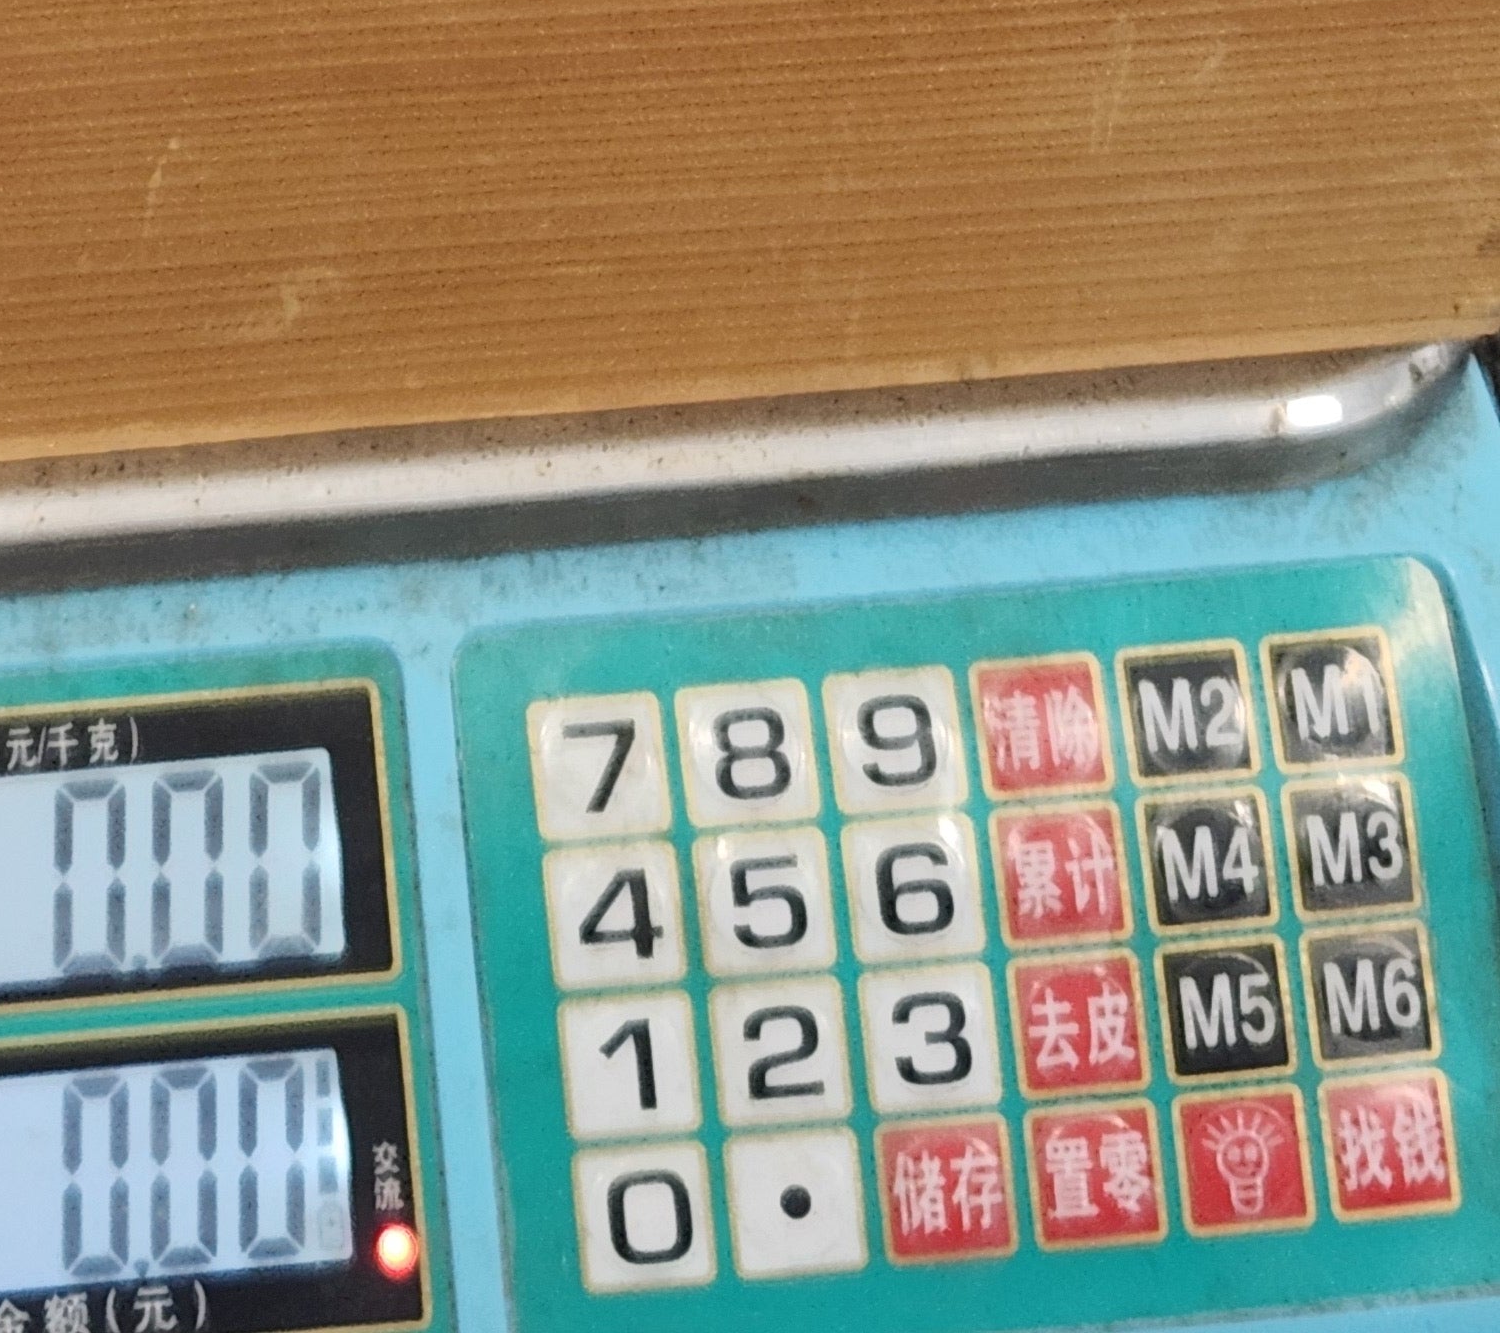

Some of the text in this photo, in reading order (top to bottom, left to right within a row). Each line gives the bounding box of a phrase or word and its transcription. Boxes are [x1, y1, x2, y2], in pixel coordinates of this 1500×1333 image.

[858, 693, 937, 786] 9
[994, 690, 1100, 773] 清除
[1141, 679, 1240, 750] M2
[1293, 664, 1384, 738] M1
[562, 718, 636, 814] 7
[714, 707, 791, 801] 8
[53, 760, 322, 975] 0.00
[875, 842, 954, 935] 6
[1014, 838, 1115, 919] 累计
[1162, 828, 1259, 900] M4
[1307, 810, 1403, 884] M3
[579, 868, 663, 958] 4
[729, 854, 809, 948] 5
[891, 992, 971, 1085] 3
[1029, 987, 1136, 1070] 去皮
[1178, 977, 1275, 1049] M5
[1325, 960, 1421, 1034] M6
[598, 1019, 658, 1111] 1
[743, 1006, 825, 1101] 2
[61, 1057, 305, 1278] 0.00
[372, 1142, 404, 1211] 交流
[1046, 1138, 1152, 1220] 置零
[1338, 1107, 1448, 1189] 找钱
[606, 1169, 693, 1265] 0
[893, 1150, 1003, 1232] 储存
